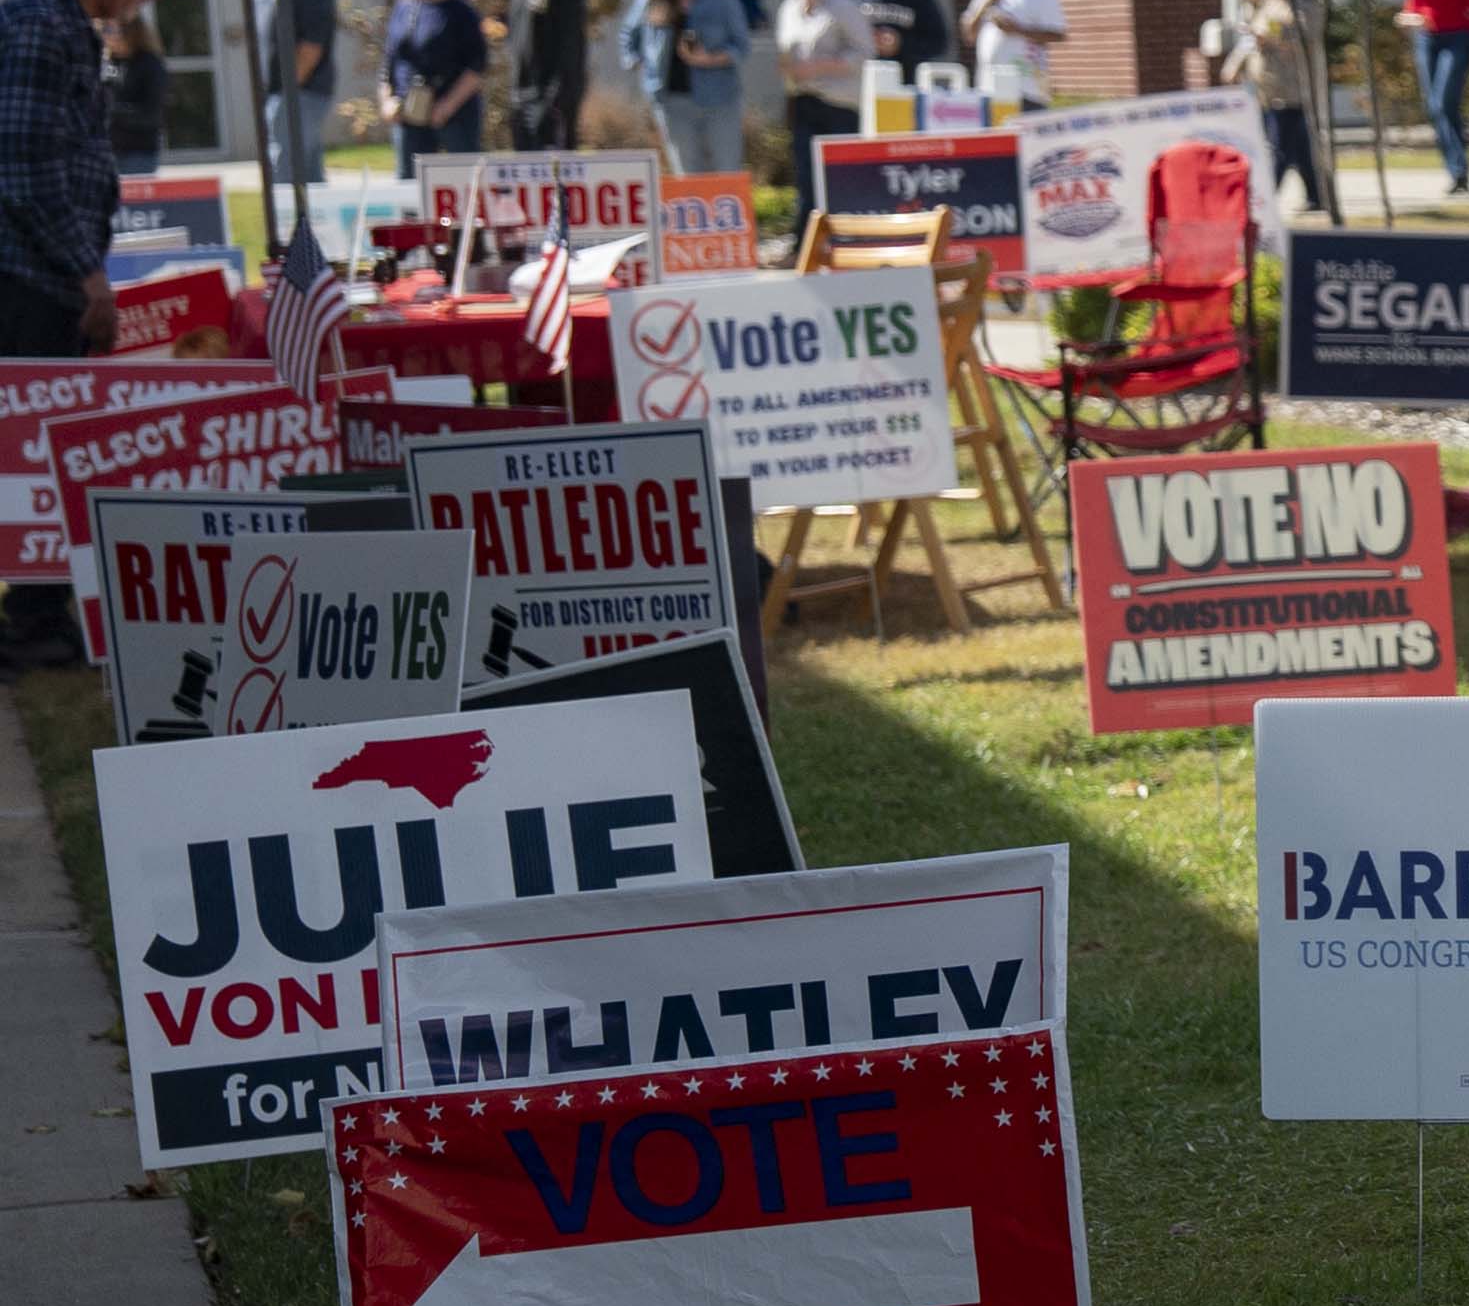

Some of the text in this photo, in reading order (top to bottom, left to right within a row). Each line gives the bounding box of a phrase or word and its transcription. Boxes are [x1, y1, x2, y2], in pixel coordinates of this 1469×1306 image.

[880, 164, 966, 201] Tyler
[1040, 176, 1111, 206] MAX
[661, 194, 746, 233] na
[707, 301, 919, 371] Vote YES
[717, 377, 932, 417] TO ALL AMENDMENTS
[62, 412, 189, 483] ELECT
[200, 394, 372, 459] SHIRL
[734, 428, 760, 448] TO
[767, 421, 818, 444] KEEP
[826, 416, 878, 439] YOUR
[505, 448, 616, 481] RE-ELECT
[778, 454, 829, 476] YOUR
[835, 445, 913, 471] POCKET
[1106, 460, 1412, 574] VOTE NO
[520, 592, 713, 629] FOR DISTRICT COURT
[1125, 588, 1413, 634] CONSTITUTIONAL
[298, 591, 450, 681] Vote YES
[1107, 620, 1441, 691] AMENDMENTS
[1302, 941, 1347, 969] US
[144, 972, 339, 1047] VON
[223, 1072, 316, 1127] for
[503, 1090, 914, 1235] VOTE
